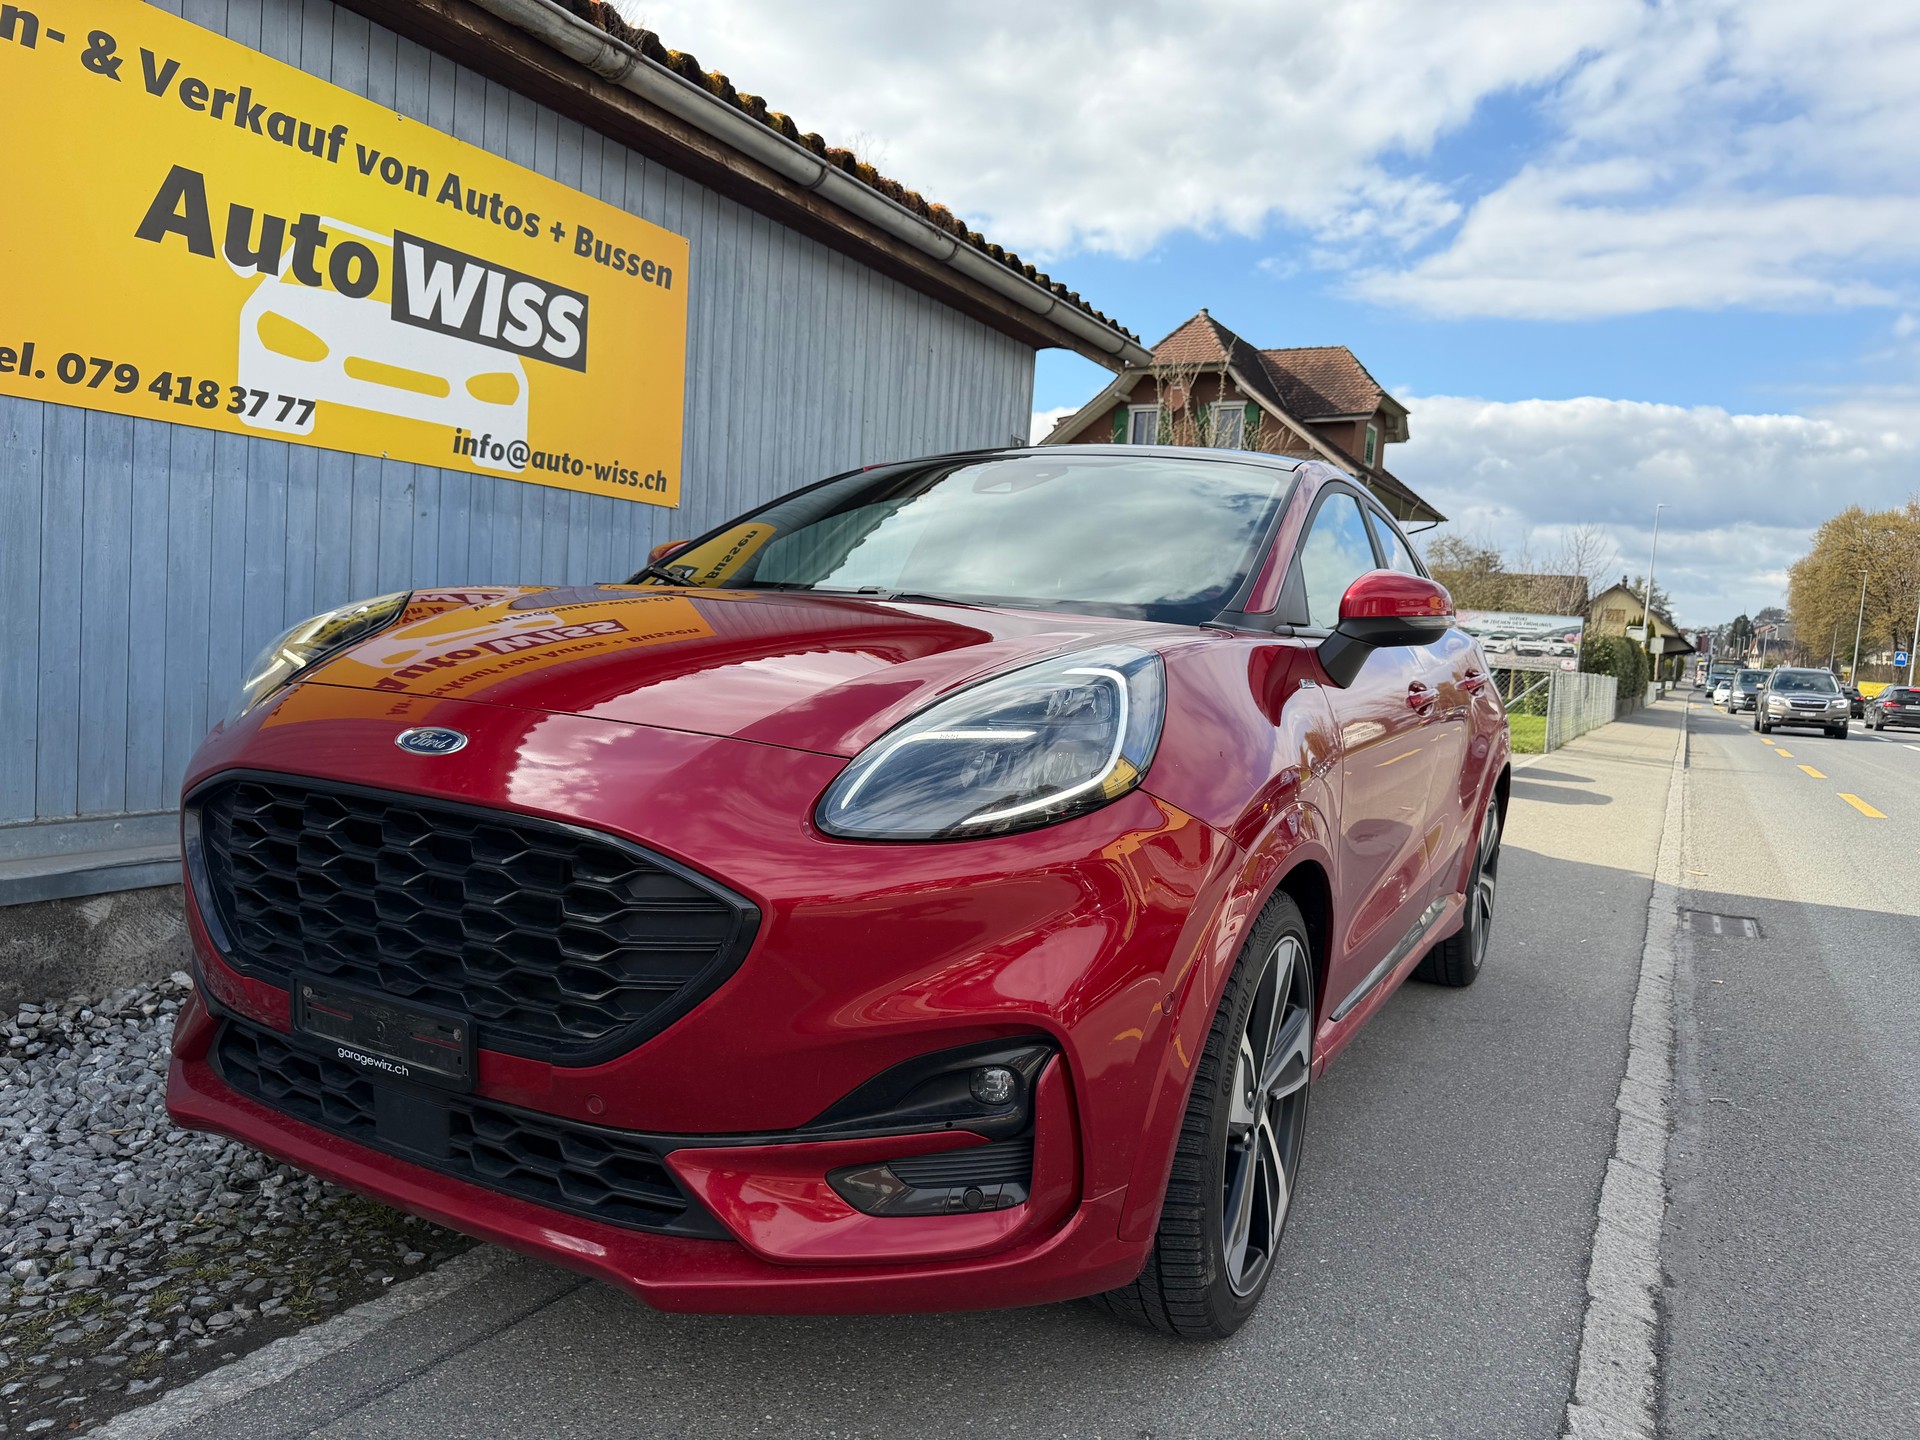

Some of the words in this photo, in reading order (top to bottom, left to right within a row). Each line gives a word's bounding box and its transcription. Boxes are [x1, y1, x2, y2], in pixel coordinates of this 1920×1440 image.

[80, 29, 124, 82] &
[139, 46, 349, 164] Verkauf
[355, 142, 430, 198] von
[435, 172, 541, 238] Autos
[549, 221, 566, 244] +
[573, 224, 673, 291] Bussen
[133, 163, 380, 299] Auto
[401, 240, 585, 360] WISS
[56, 352, 140, 394] 079
[147, 370, 220, 410] 418
[225, 385, 270, 417] 37
[274, 394, 316, 426] 77
[452, 427, 668, 493] info@auto-wiss.ch
[337, 1047, 409, 1077] garagewirz.ch
